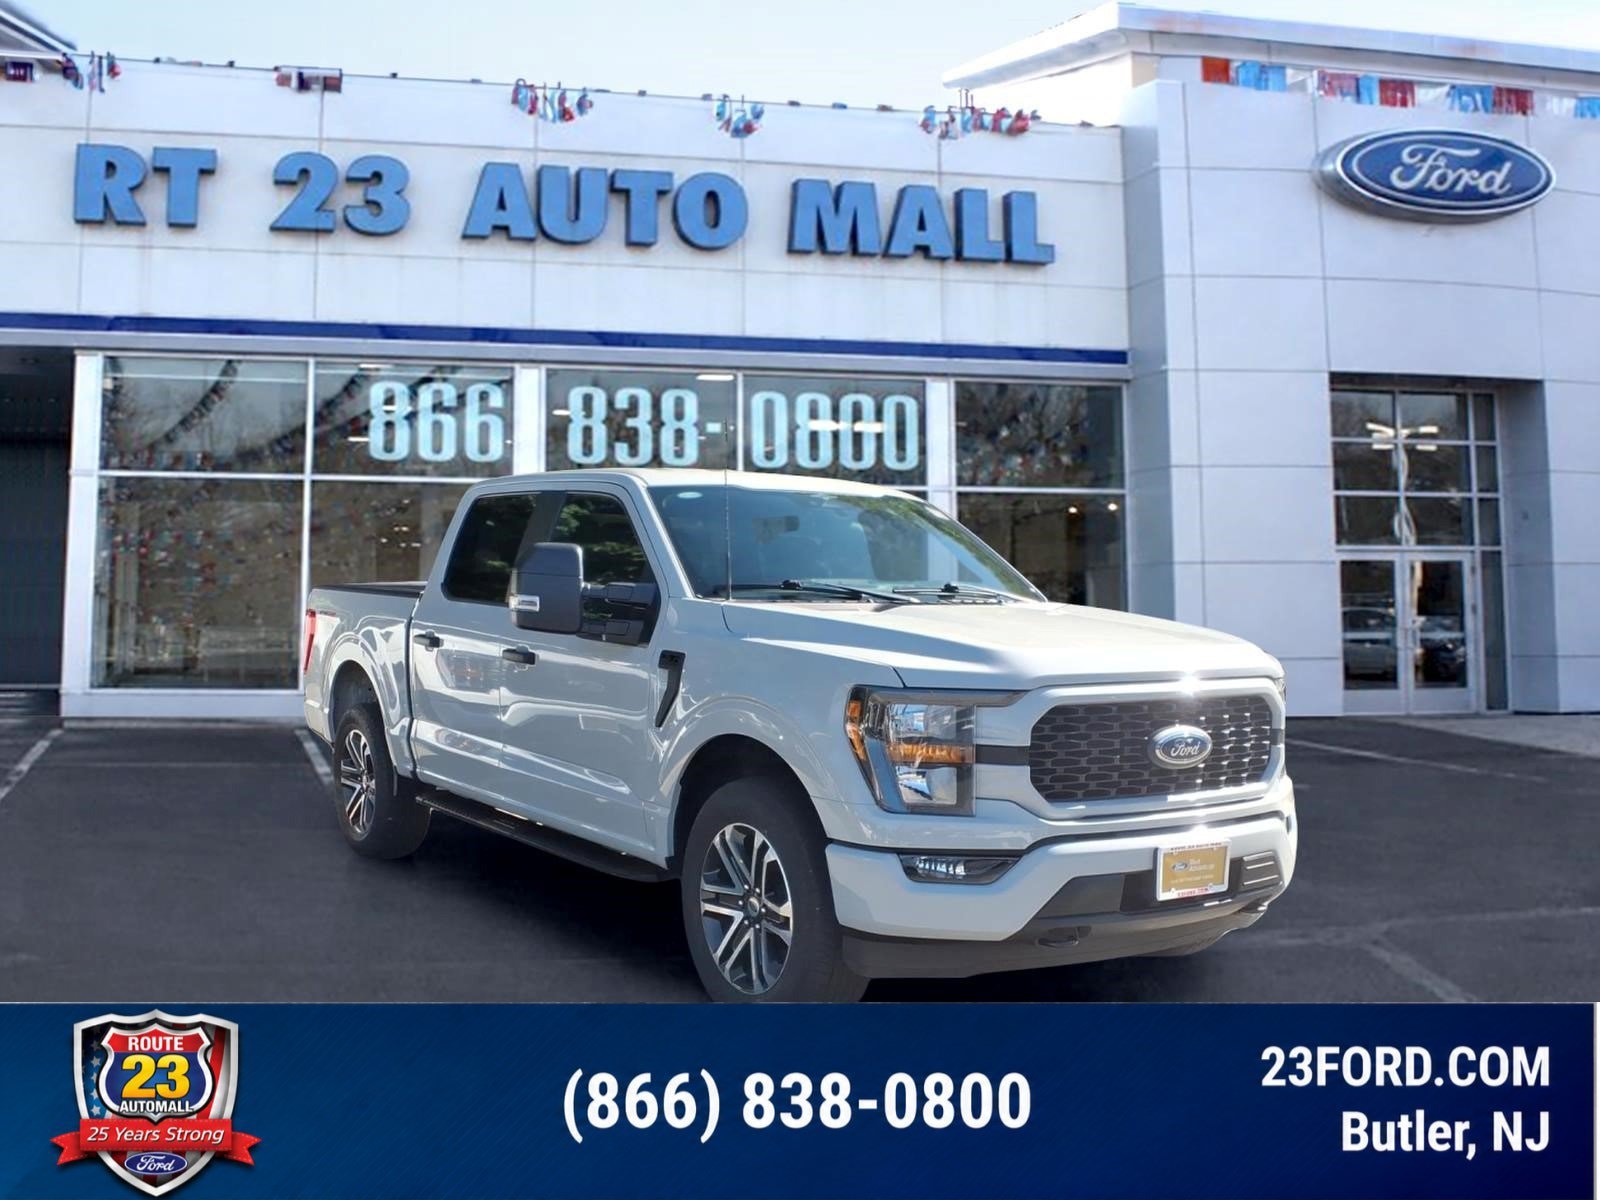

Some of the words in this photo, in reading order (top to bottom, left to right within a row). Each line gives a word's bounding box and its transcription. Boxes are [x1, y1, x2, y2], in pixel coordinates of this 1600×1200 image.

[1390, 143, 1511, 194] Ford
[74, 143, 217, 228] RT
[269, 151, 410, 236] 23
[461, 161, 748, 251] AUTO
[787, 178, 1056, 266] MALL
[368, 381, 504, 463] 866
[1170, 739, 1201, 757] Ford
